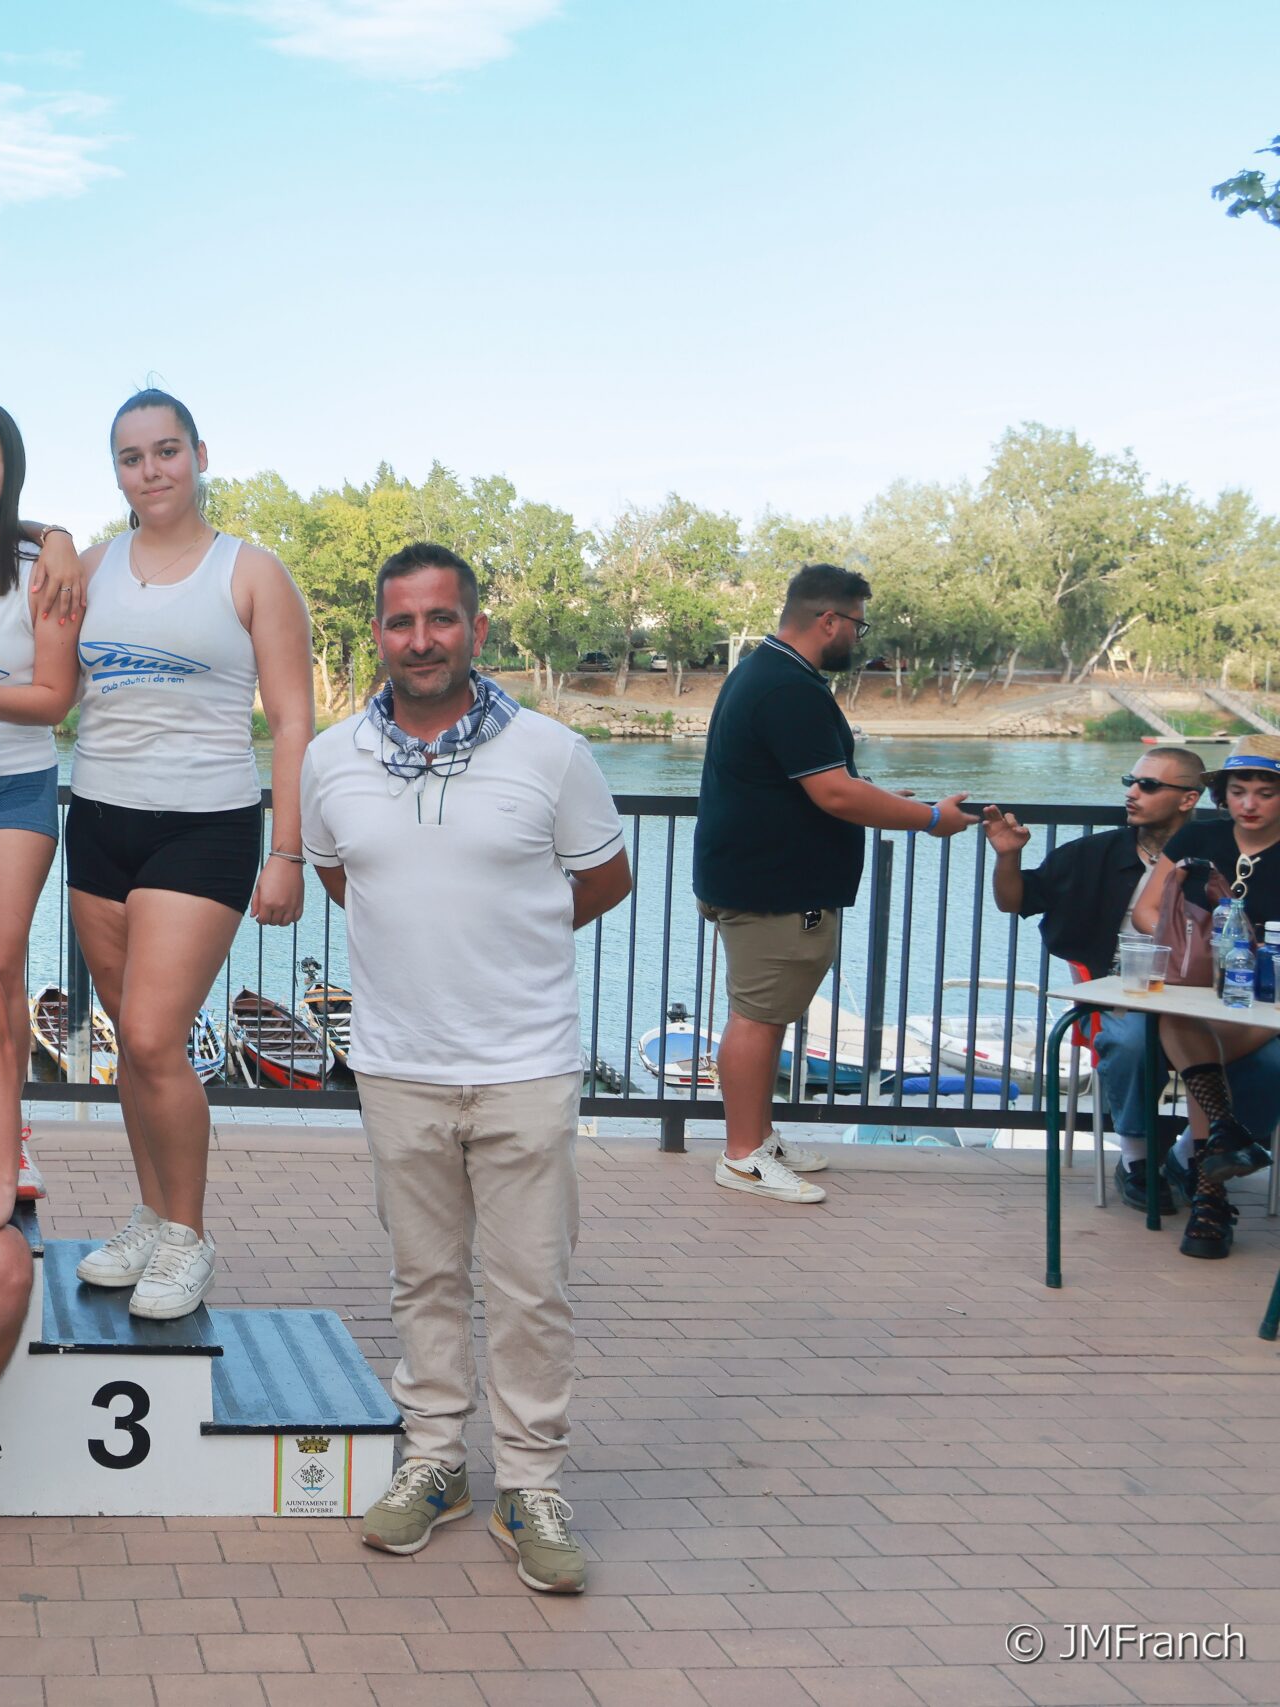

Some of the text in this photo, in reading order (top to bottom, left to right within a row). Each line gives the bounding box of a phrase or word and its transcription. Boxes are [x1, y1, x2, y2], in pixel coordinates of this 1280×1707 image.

[101, 682, 118, 694] Club
[153, 674, 165, 683] de
[88, 1380, 151, 1469] 3
